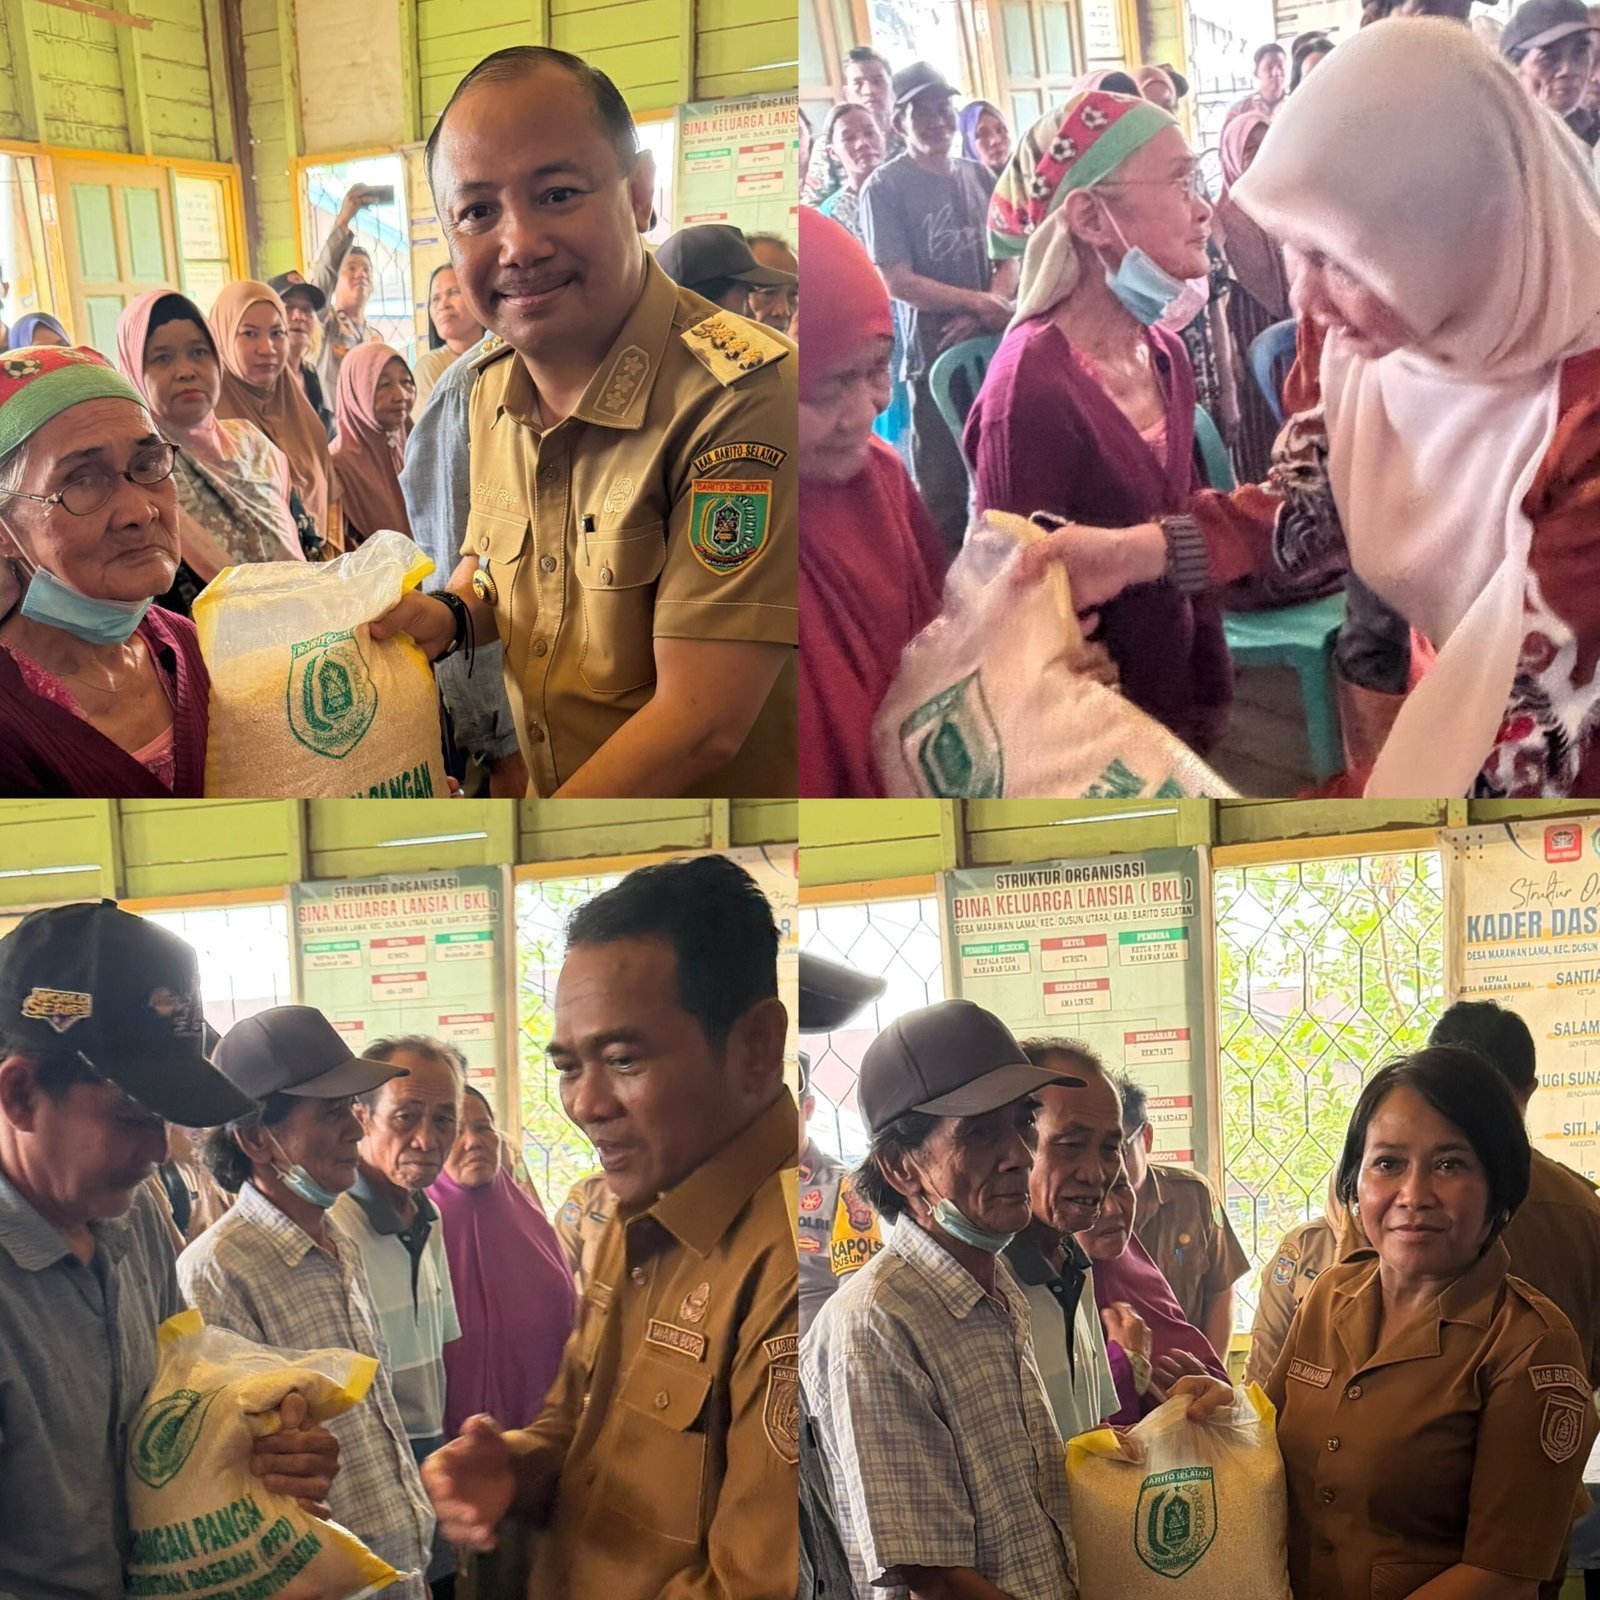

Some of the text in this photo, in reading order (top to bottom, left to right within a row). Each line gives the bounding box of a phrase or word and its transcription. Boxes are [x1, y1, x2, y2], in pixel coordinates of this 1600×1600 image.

[714, 101, 757, 115] STRUKTUR
[683, 121, 708, 136] BINA
[712, 113, 764, 133] KELUARGA
[714, 445, 743, 462] BARITO
[746, 444, 782, 465] SELATAN
[696, 482, 768, 493] BARITO SELATAN
[996, 862, 1145, 889] STRUKTUR ORGANISASI
[334, 878, 459, 899] STRUKTUR ORGANISASI
[298, 905, 329, 922] BINA
[334, 899, 398, 920] KELUARGA
[402, 895, 449, 915] LANSIA
[953, 897, 992, 919] BINA
[996, 889, 1073, 915] KELUARGA
[1078, 884, 1134, 909] LANSIA
[1152, 880, 1181, 902] BKL
[955, 925, 974, 935] DESA
[976, 921, 1014, 932] MARAWAN
[1058, 916, 1084, 925] DUSUN
[1132, 909, 1159, 919] BARITO
[1161, 906, 1193, 917] SELATAN
[1467, 906, 1598, 943] KADER DAS
[1467, 951, 1486, 960] DESA
[1488, 948, 1527, 959] MARAWAN
[1553, 944, 1571, 954] KEC.
[1572, 942, 1598, 952] DUSUN
[1460, 985, 1478, 994] DESA
[1513, 981, 1531, 990] LAMA
[1483, 975, 1508, 983] KEPALA
[1146, 1099, 1175, 1108] NGGOTA
[1563, 1122, 1587, 1136] SITI
[1146, 1153, 1178, 1162] NGGOTA
[1142, 1469, 1210, 1487] ARITO SELATAN
